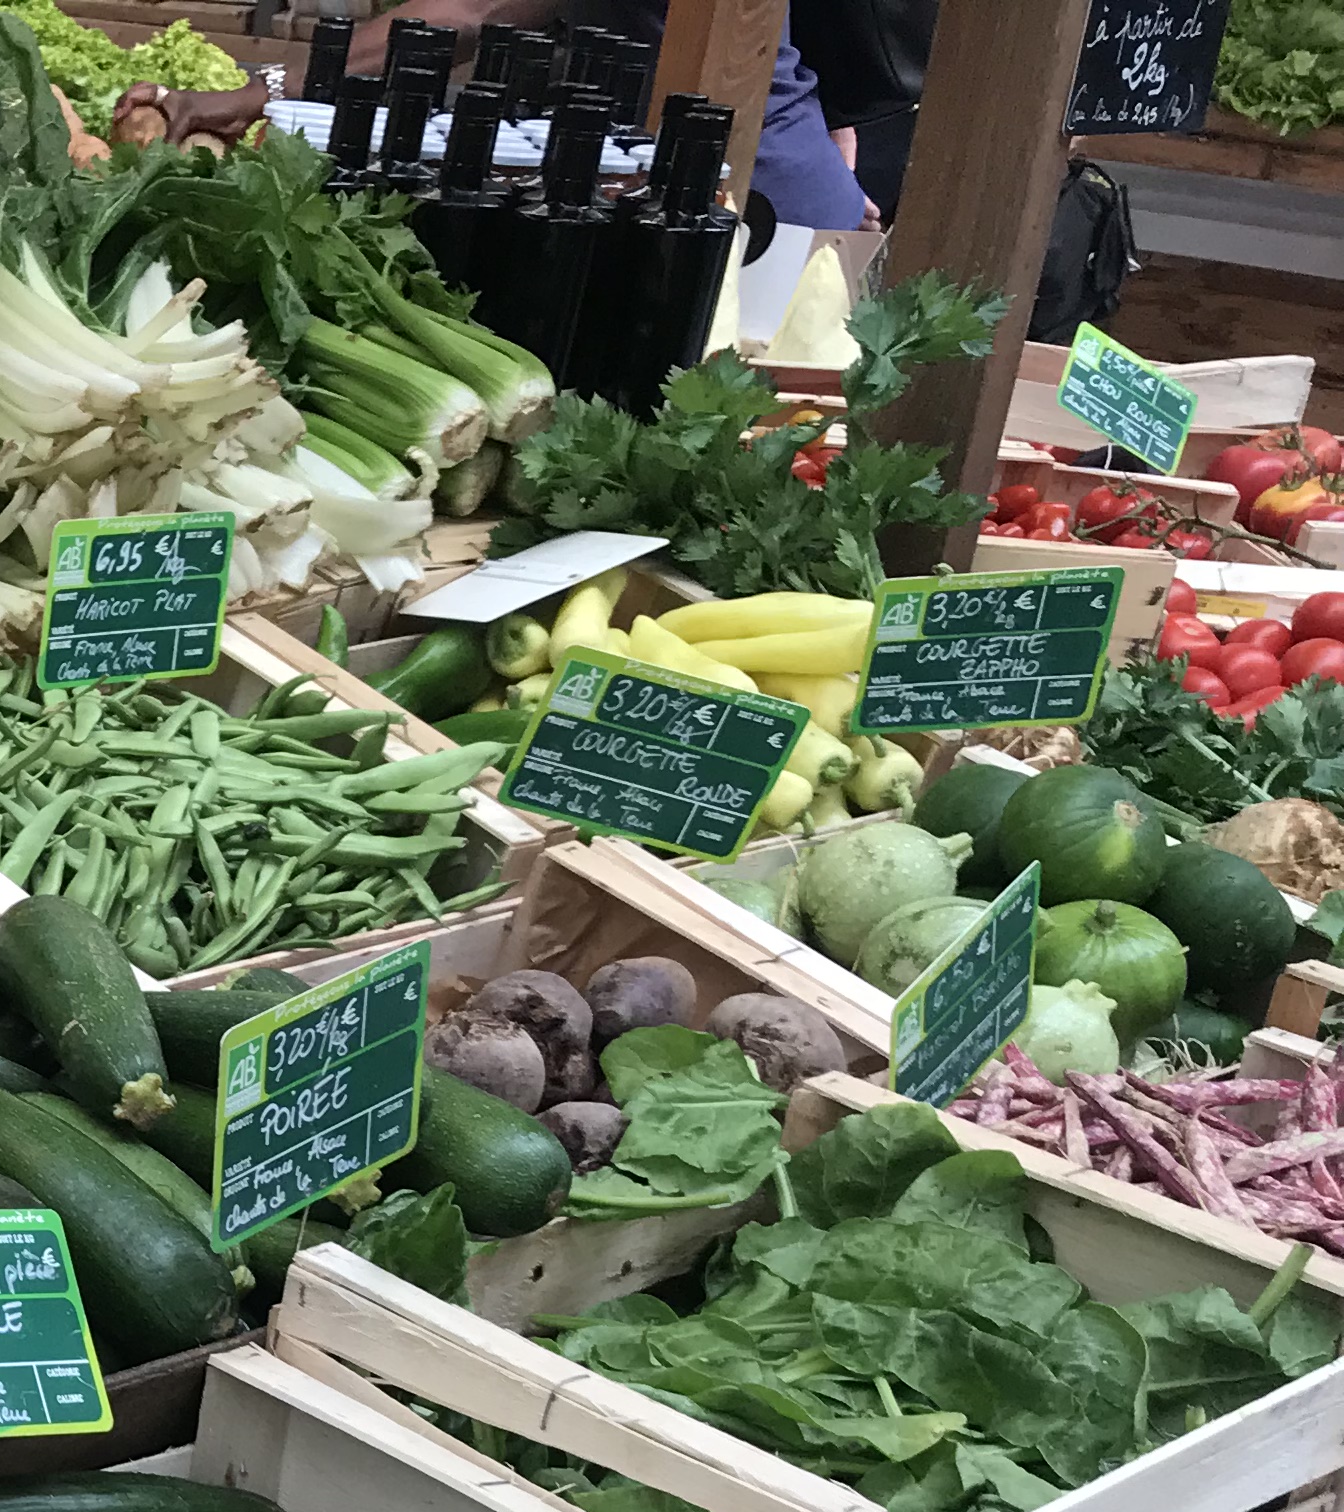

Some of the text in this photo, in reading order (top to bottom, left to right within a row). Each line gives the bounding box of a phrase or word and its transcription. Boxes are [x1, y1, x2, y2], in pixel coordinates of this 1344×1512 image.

[1115, 3, 1174, 64] partir
[1176, 1, 1203, 40] de
[1089, 375, 1122, 400] CHOU
[1126, 402, 1172, 438] ROUGE
[95, 540, 223, 574] 6,95 €
[154, 589, 197, 612] PLAT
[1013, 590, 1036, 610] €
[1090, 595, 1106, 610] €
[916, 633, 1052, 664] COURGETTE
[692, 704, 717, 726] €
[766, 732, 785, 749] €
[572, 728, 701, 774] COURGETTE
[675, 776, 752, 809] RONDE
[340, 997, 361, 1026] €
[403, 980, 419, 1001] €
